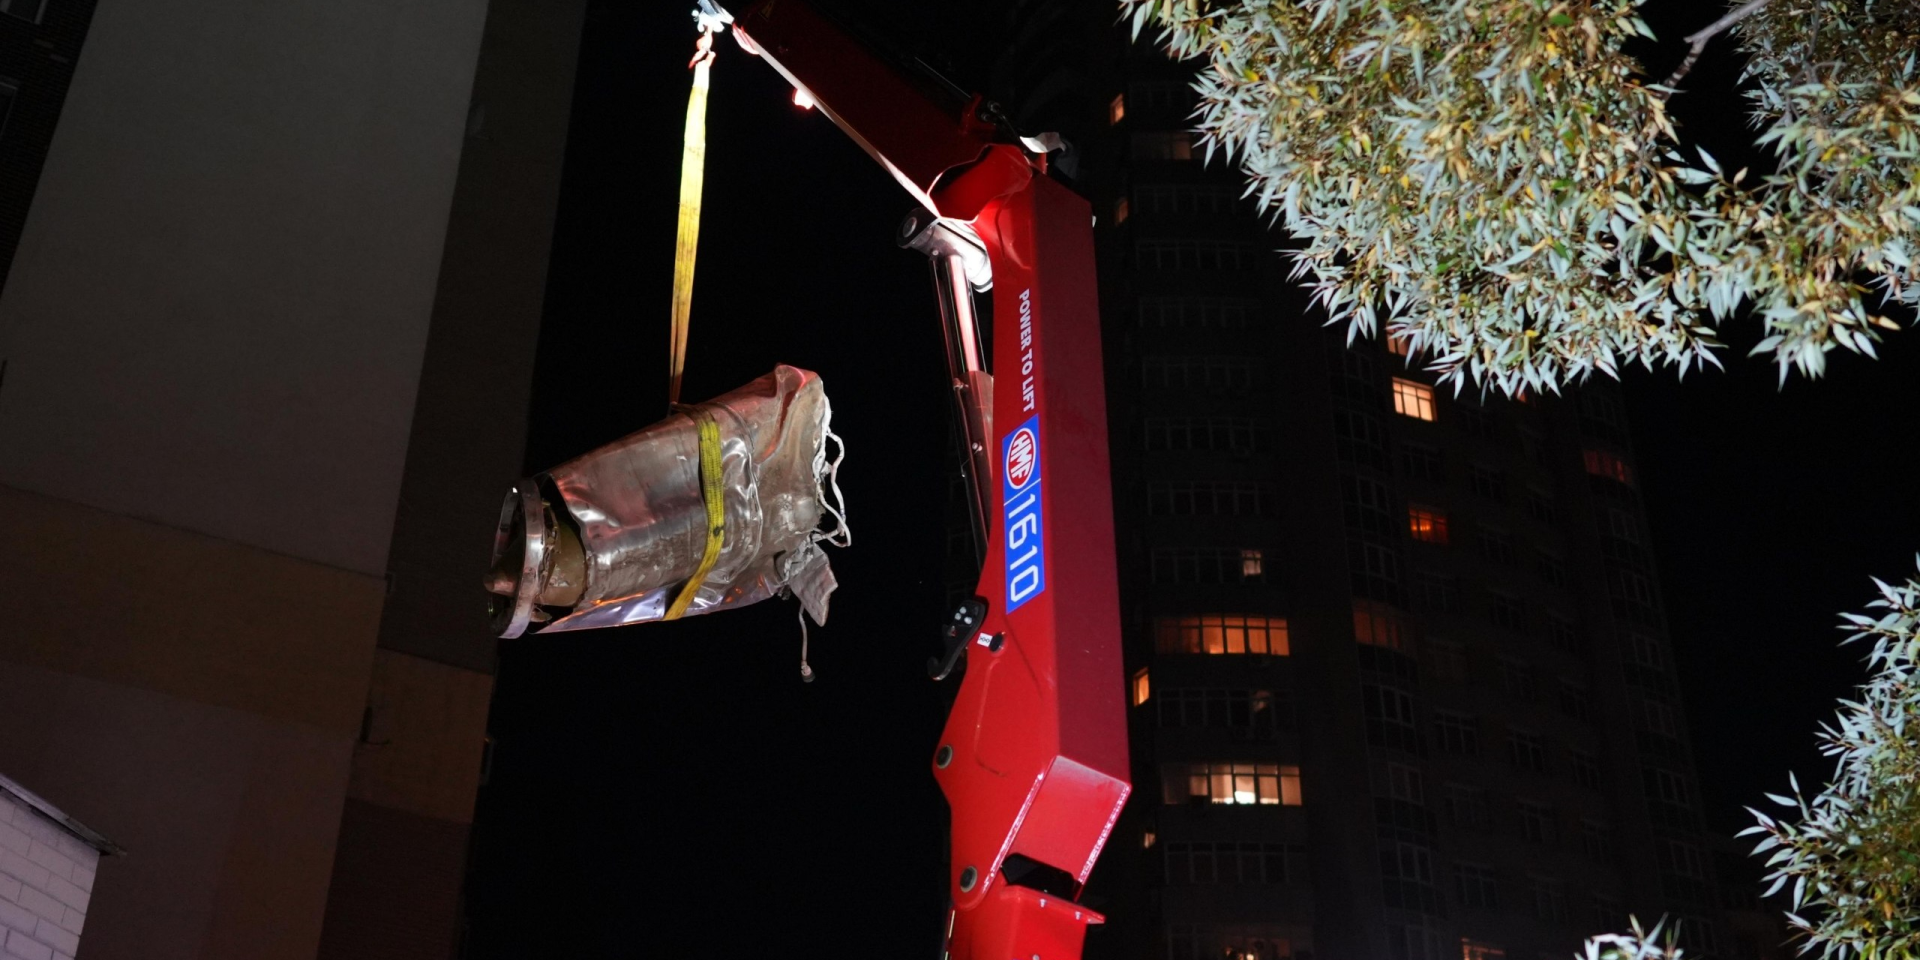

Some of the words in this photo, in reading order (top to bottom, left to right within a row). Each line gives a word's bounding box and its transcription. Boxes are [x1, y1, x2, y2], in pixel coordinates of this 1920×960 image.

[1019, 288, 1032, 351] POWER
[1021, 348, 1033, 376] TO
[1022, 376, 1035, 412] LIFT
[1010, 434, 1034, 480] HMF
[1009, 493, 1039, 602] 1610
